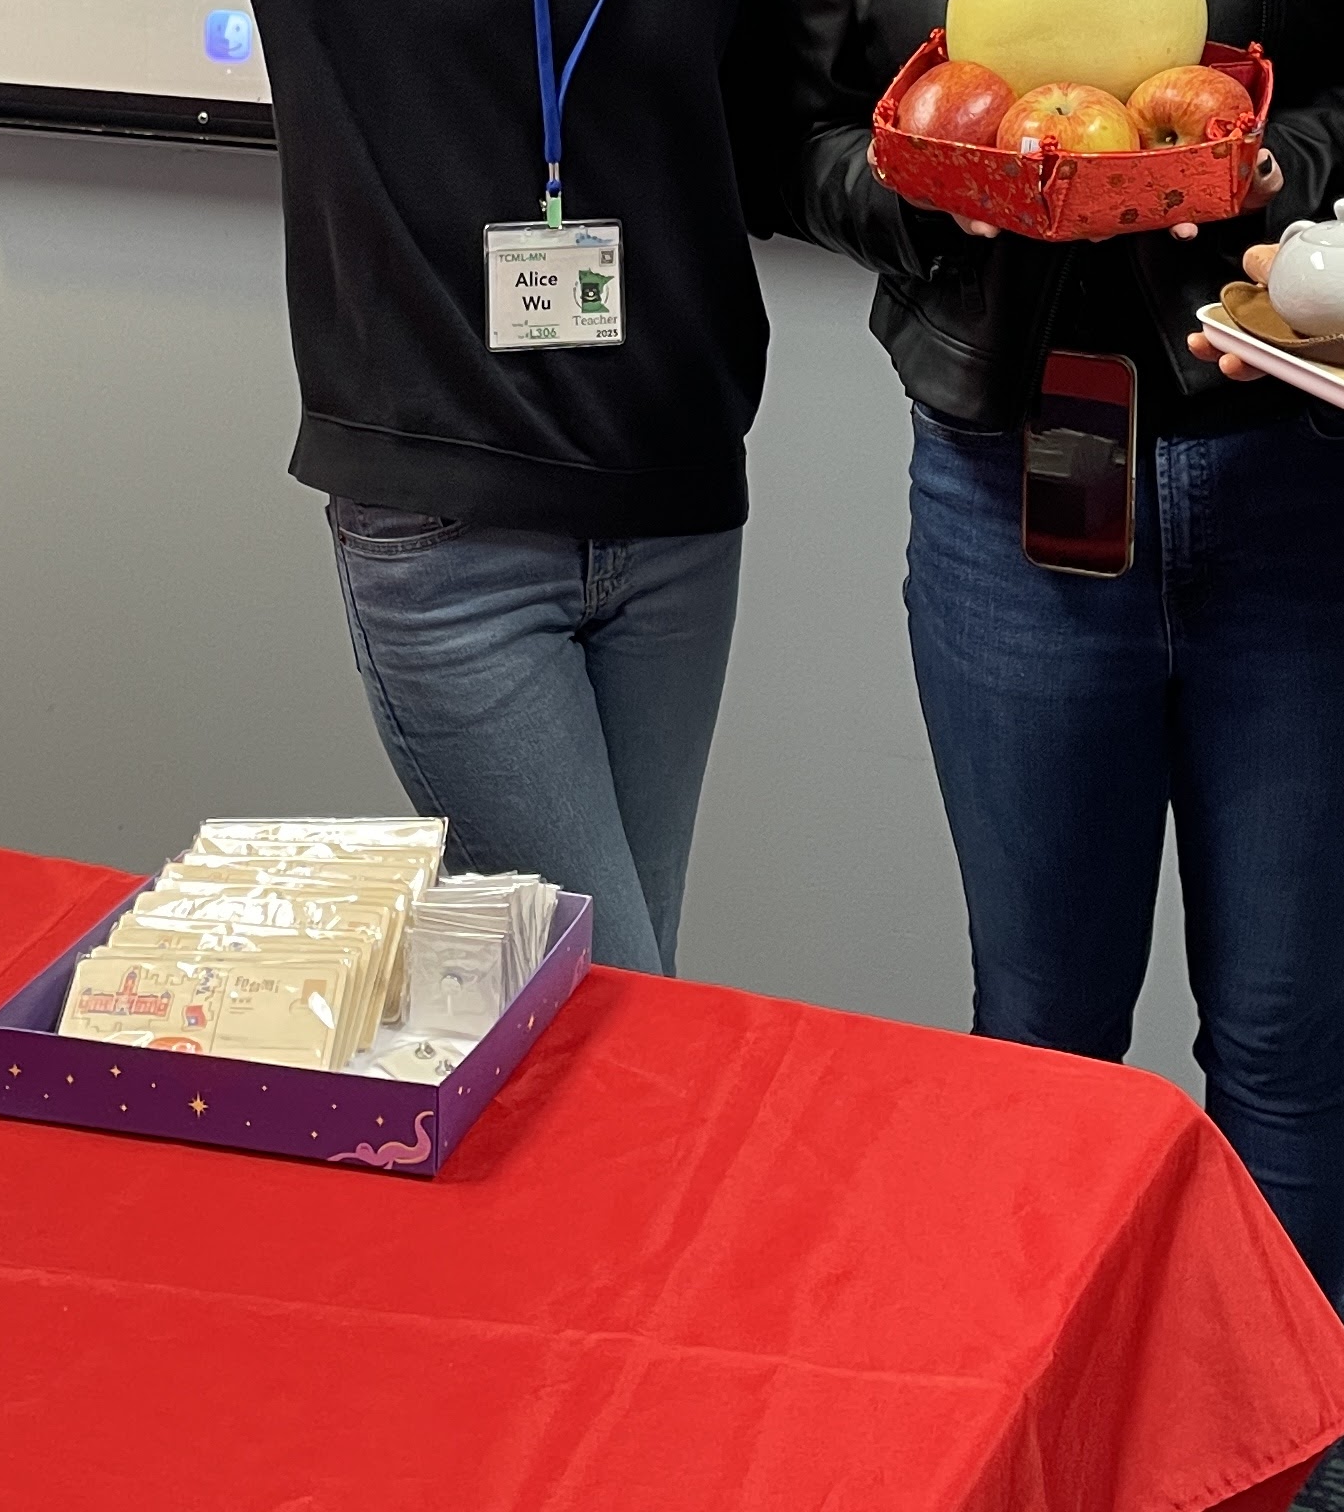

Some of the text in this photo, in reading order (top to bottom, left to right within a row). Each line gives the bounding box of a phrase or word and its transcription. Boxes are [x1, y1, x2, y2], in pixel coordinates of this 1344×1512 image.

[514, 272, 558, 288] Alice
[522, 296, 551, 310] Wu
[572, 314, 618, 326] Teacher
[529, 327, 557, 339] L306
